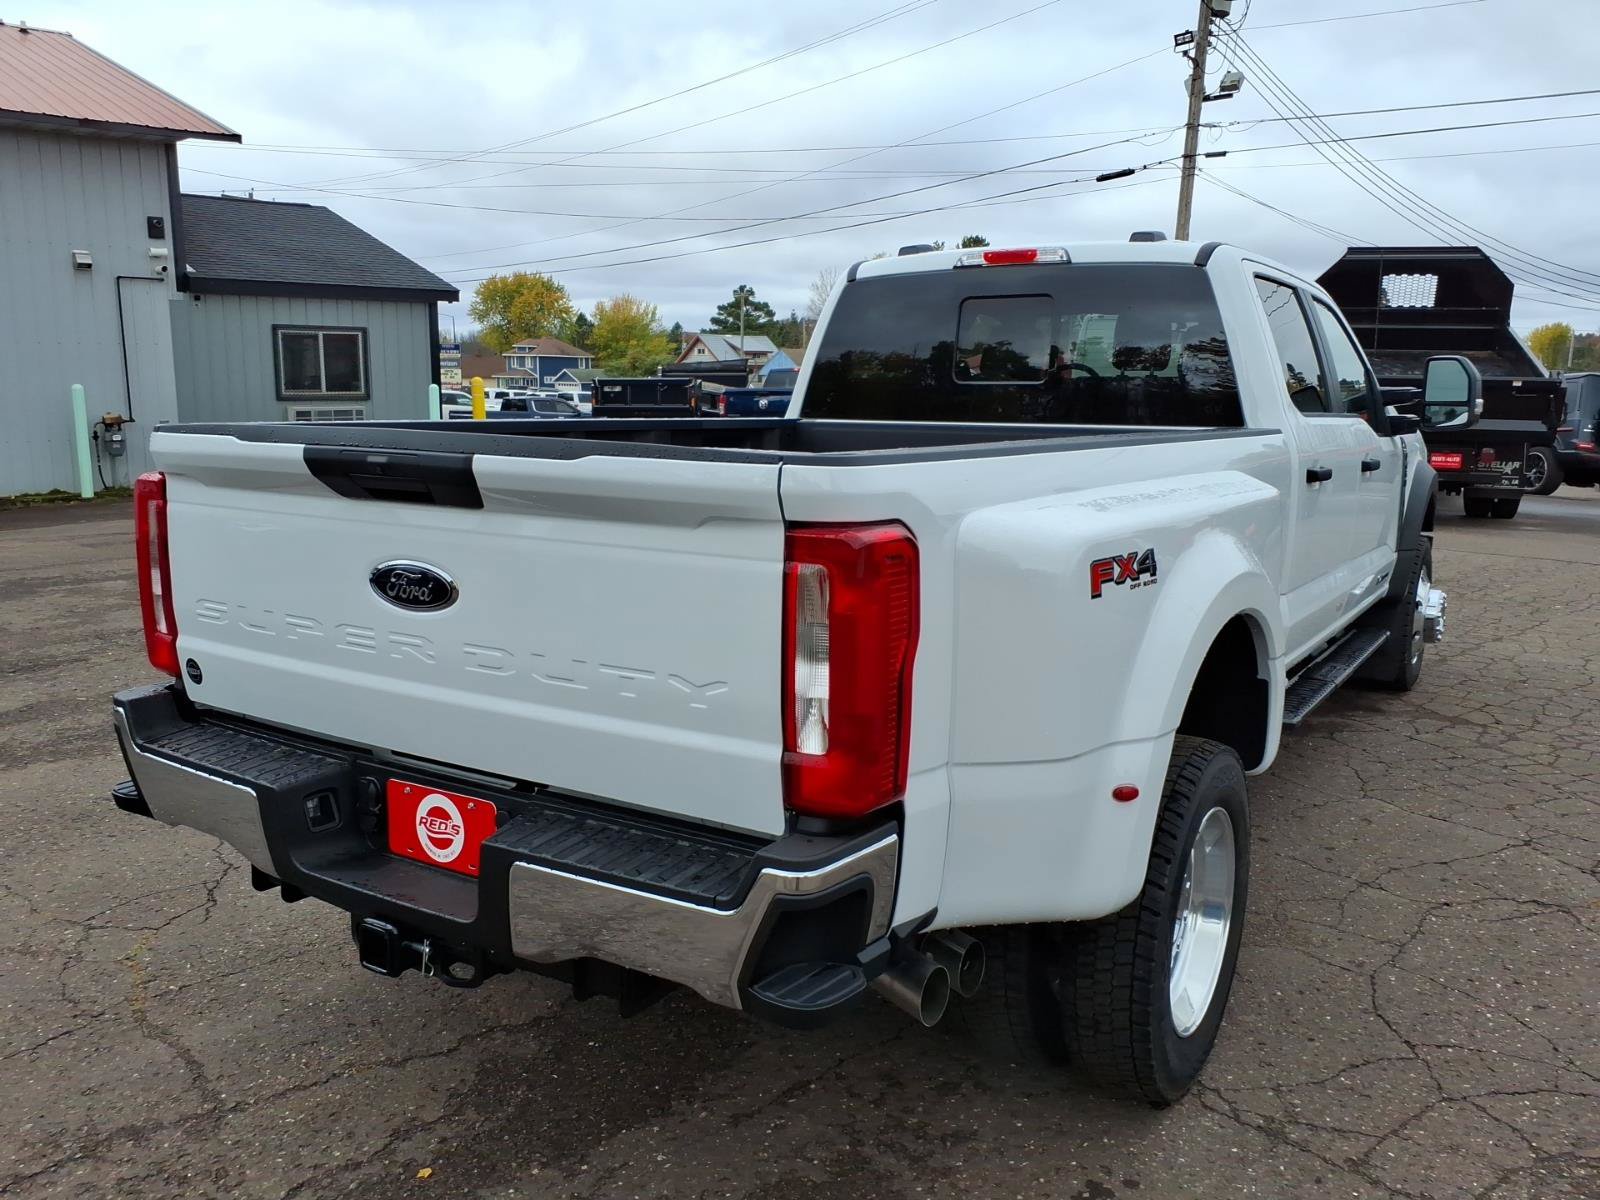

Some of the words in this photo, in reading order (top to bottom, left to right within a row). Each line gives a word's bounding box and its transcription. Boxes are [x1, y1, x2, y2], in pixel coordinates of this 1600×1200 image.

[385, 570, 434, 602] Ford
[1089, 547, 1158, 600] FX4
[1129, 581, 1142, 591] OFF
[1142, 578, 1158, 588] ROAD
[195, 598, 437, 664] SUPER
[462, 642, 729, 708] DUTY
[418, 815, 461, 836] RED'S
